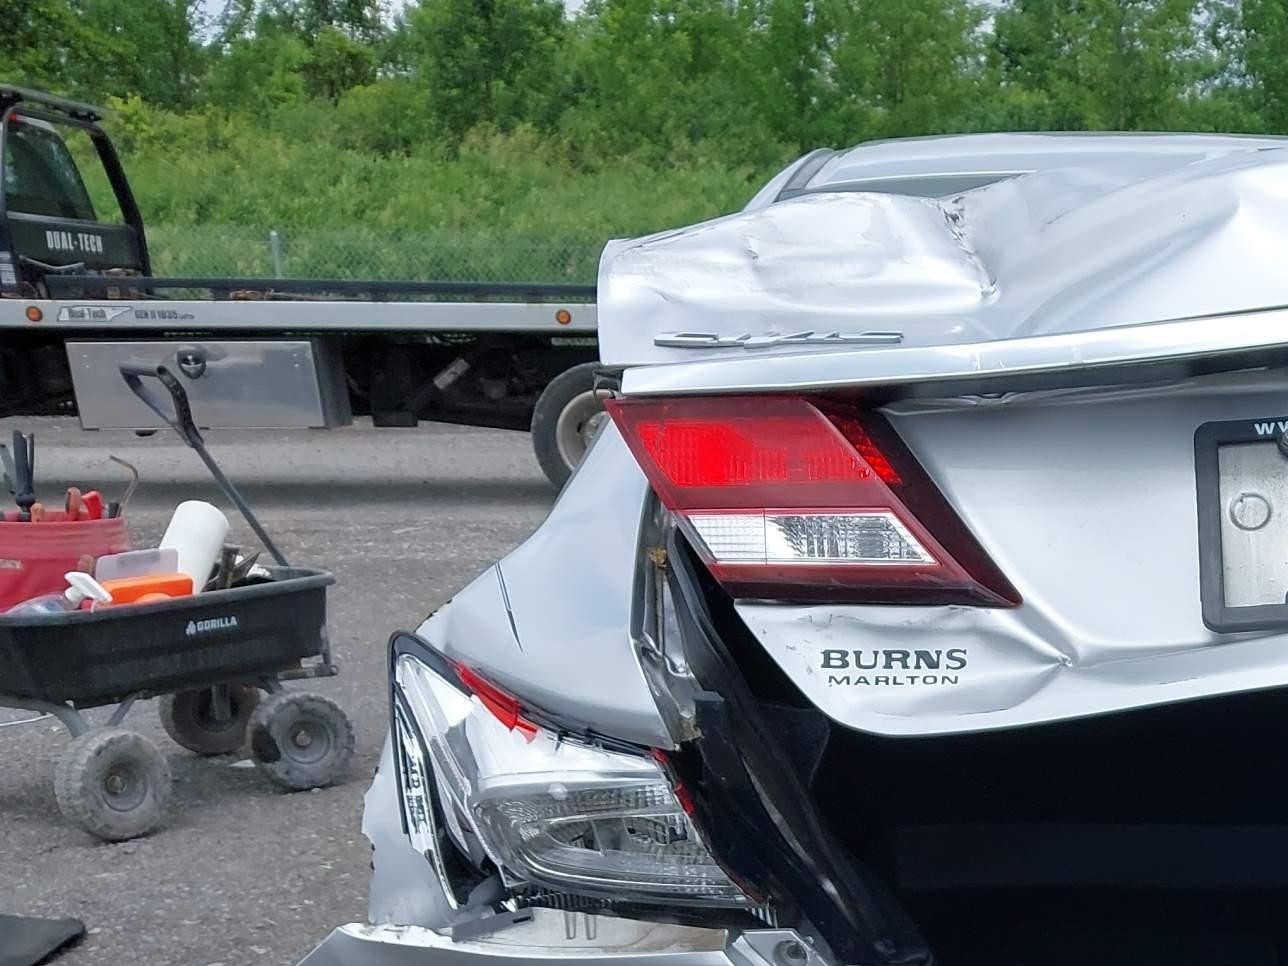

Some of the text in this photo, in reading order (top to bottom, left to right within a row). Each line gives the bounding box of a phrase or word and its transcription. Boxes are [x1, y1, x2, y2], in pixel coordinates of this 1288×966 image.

[197, 616, 237, 631] GORILLA
[821, 649, 967, 670] BURNS
[829, 676, 958, 686] MARLTON
